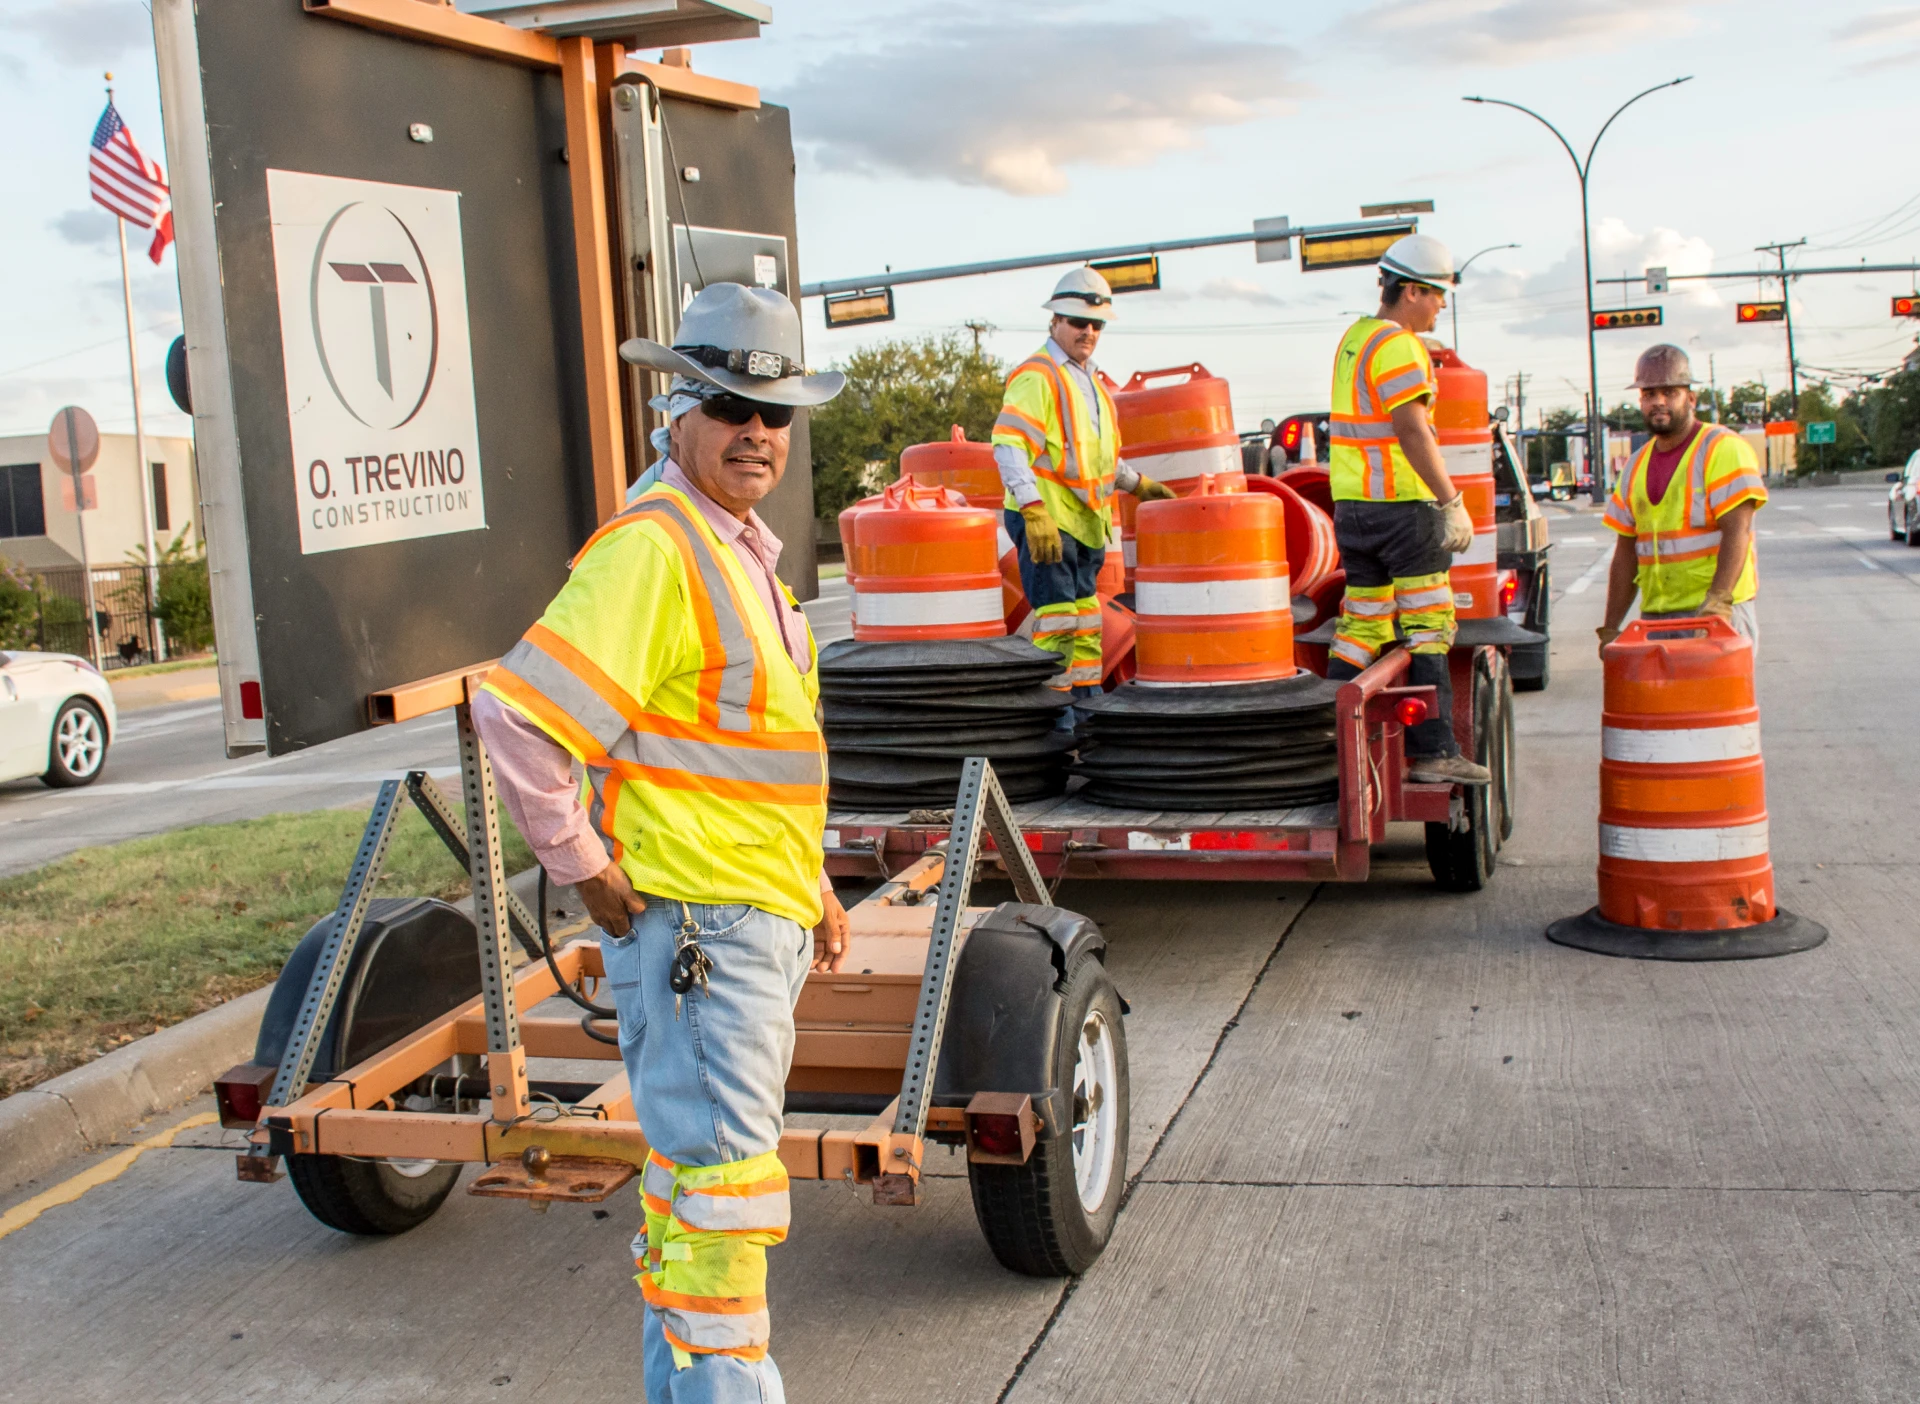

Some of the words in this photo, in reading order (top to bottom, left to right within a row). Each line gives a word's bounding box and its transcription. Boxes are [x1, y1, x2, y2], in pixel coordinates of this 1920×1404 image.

[309, 459, 336, 499] O.
[345, 448, 465, 495] TREVINO
[312, 490, 468, 530] CONSTRUCTION
